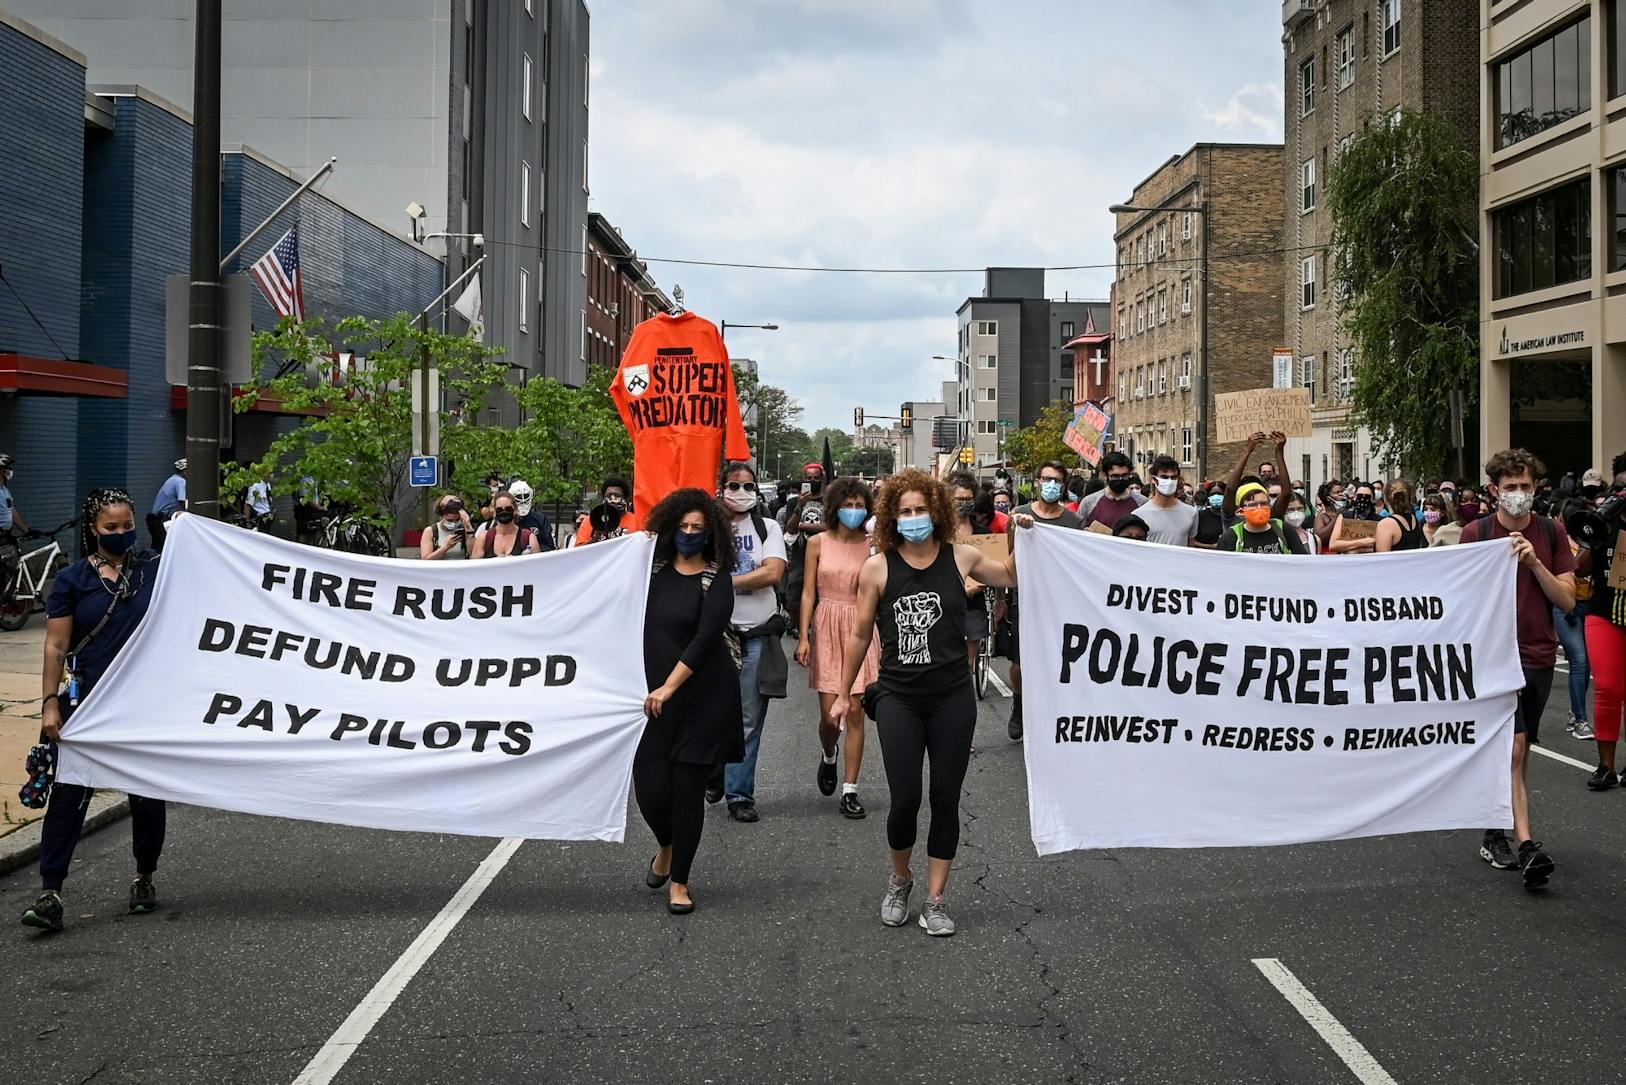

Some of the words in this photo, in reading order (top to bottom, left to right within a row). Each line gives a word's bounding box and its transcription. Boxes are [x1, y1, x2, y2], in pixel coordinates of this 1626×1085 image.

[1510, 342, 1519, 353] THE
[1520, 337, 1545, 352] AMERICAN
[1545, 335, 1556, 347] LAW
[1557, 330, 1584, 345] INSTITUTE
[654, 355, 698, 364] PENITENTIARY
[652, 362, 727, 395] SUPER
[628, 394, 727, 431] PREDATOR
[1216, 398, 1243, 412] CIVIC
[1267, 419, 1306, 435] SPRAY
[262, 563, 377, 612] FIRE
[392, 585, 534, 620] RUSH
[1106, 584, 1198, 615] DIVEST
[1225, 594, 1318, 623] DEFUND
[1344, 597, 1444, 622] DISBAND
[897, 611, 935, 628] BLACK
[198, 618, 416, 683] DEFUND
[435, 655, 578, 687] UPPD
[902, 633, 927, 652] LIVES
[1060, 624, 1228, 696] POLICE
[1236, 646, 1350, 706] FREE
[1364, 644, 1477, 704] PENN
[202, 693, 322, 736] PAY
[330, 713, 534, 756] PILOTS
[1055, 715, 1179, 744] REINVEST
[1202, 725, 1315, 752] REDRESS
[1343, 721, 1476, 751] REIMAGINE
